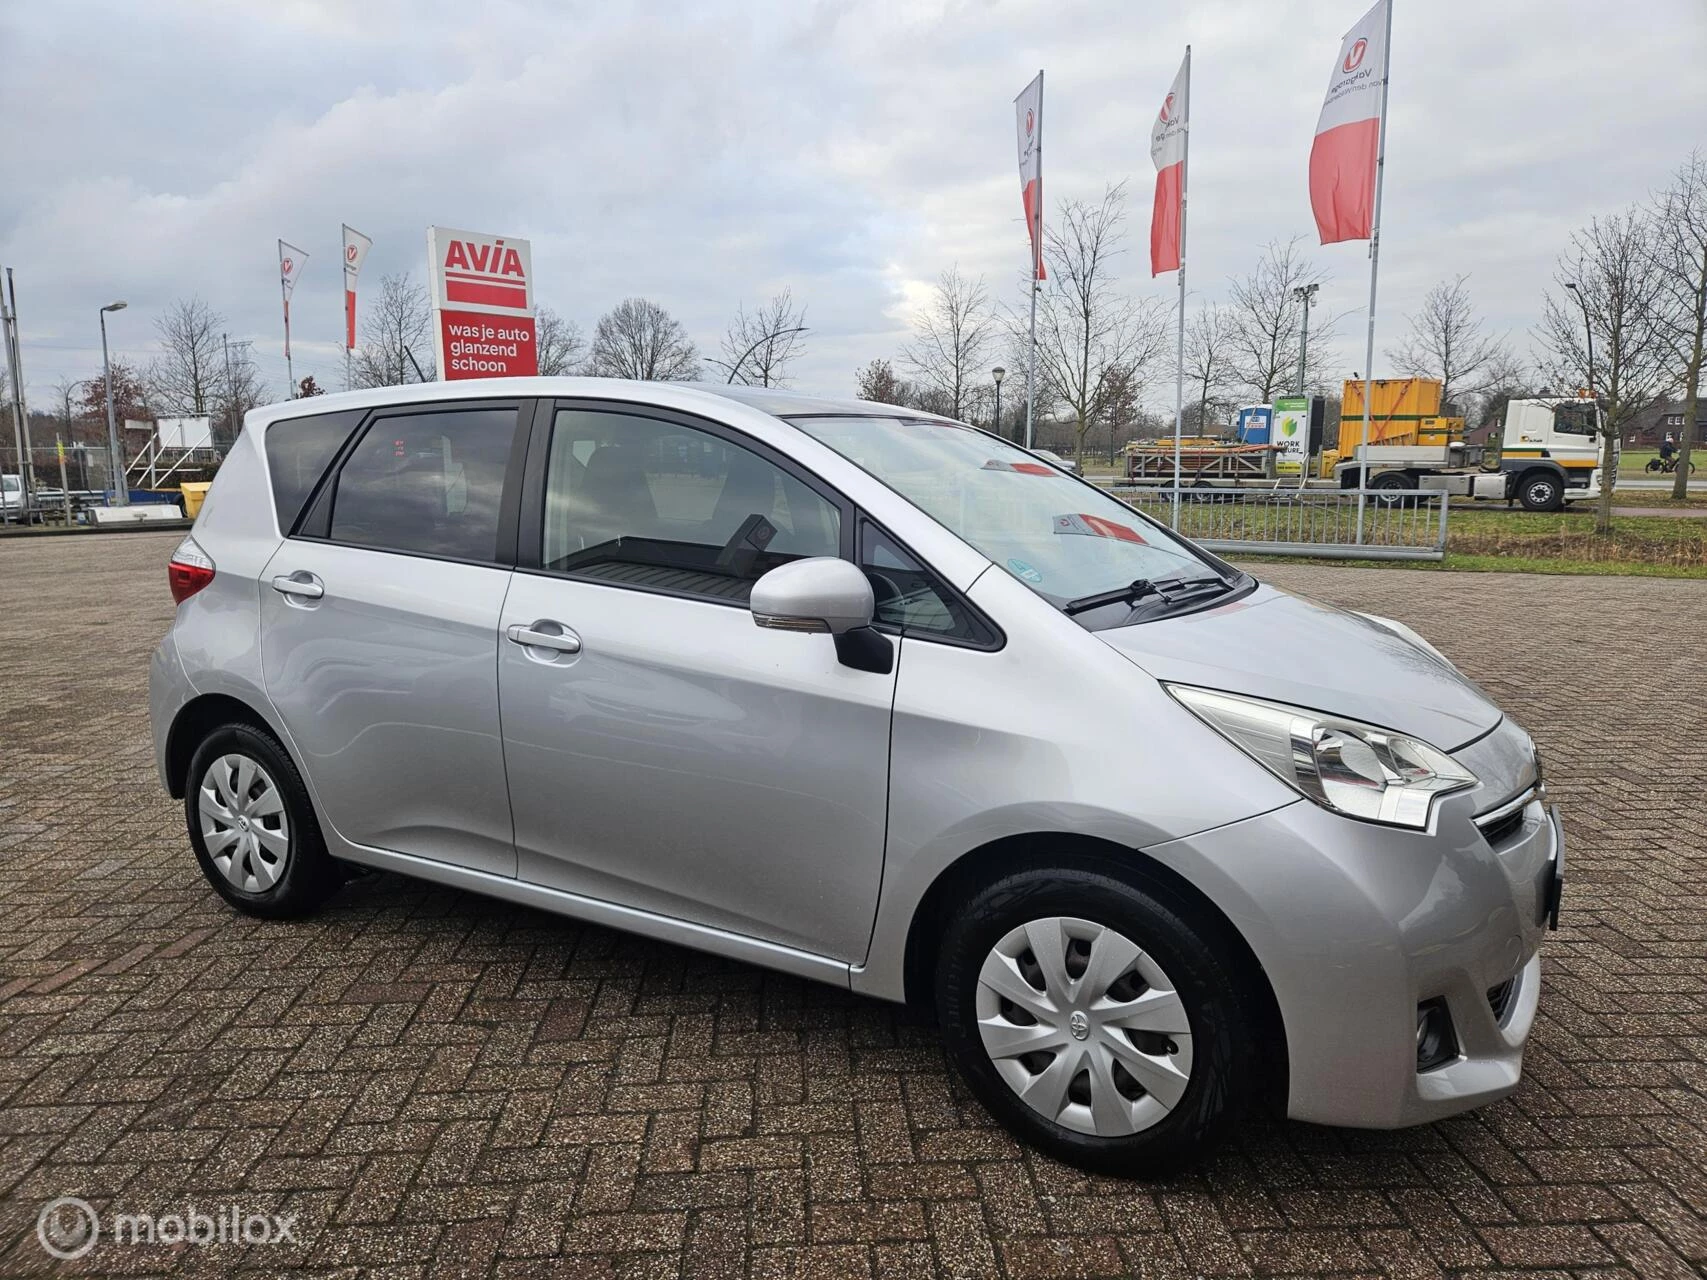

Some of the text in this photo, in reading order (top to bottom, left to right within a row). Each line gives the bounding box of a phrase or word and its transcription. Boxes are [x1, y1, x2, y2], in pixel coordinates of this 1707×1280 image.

[449, 324, 530, 342] was je auto
[450, 339, 517, 357] glanzend
[451, 357, 507, 373] schoon
[1276, 440, 1300, 448] WORK
